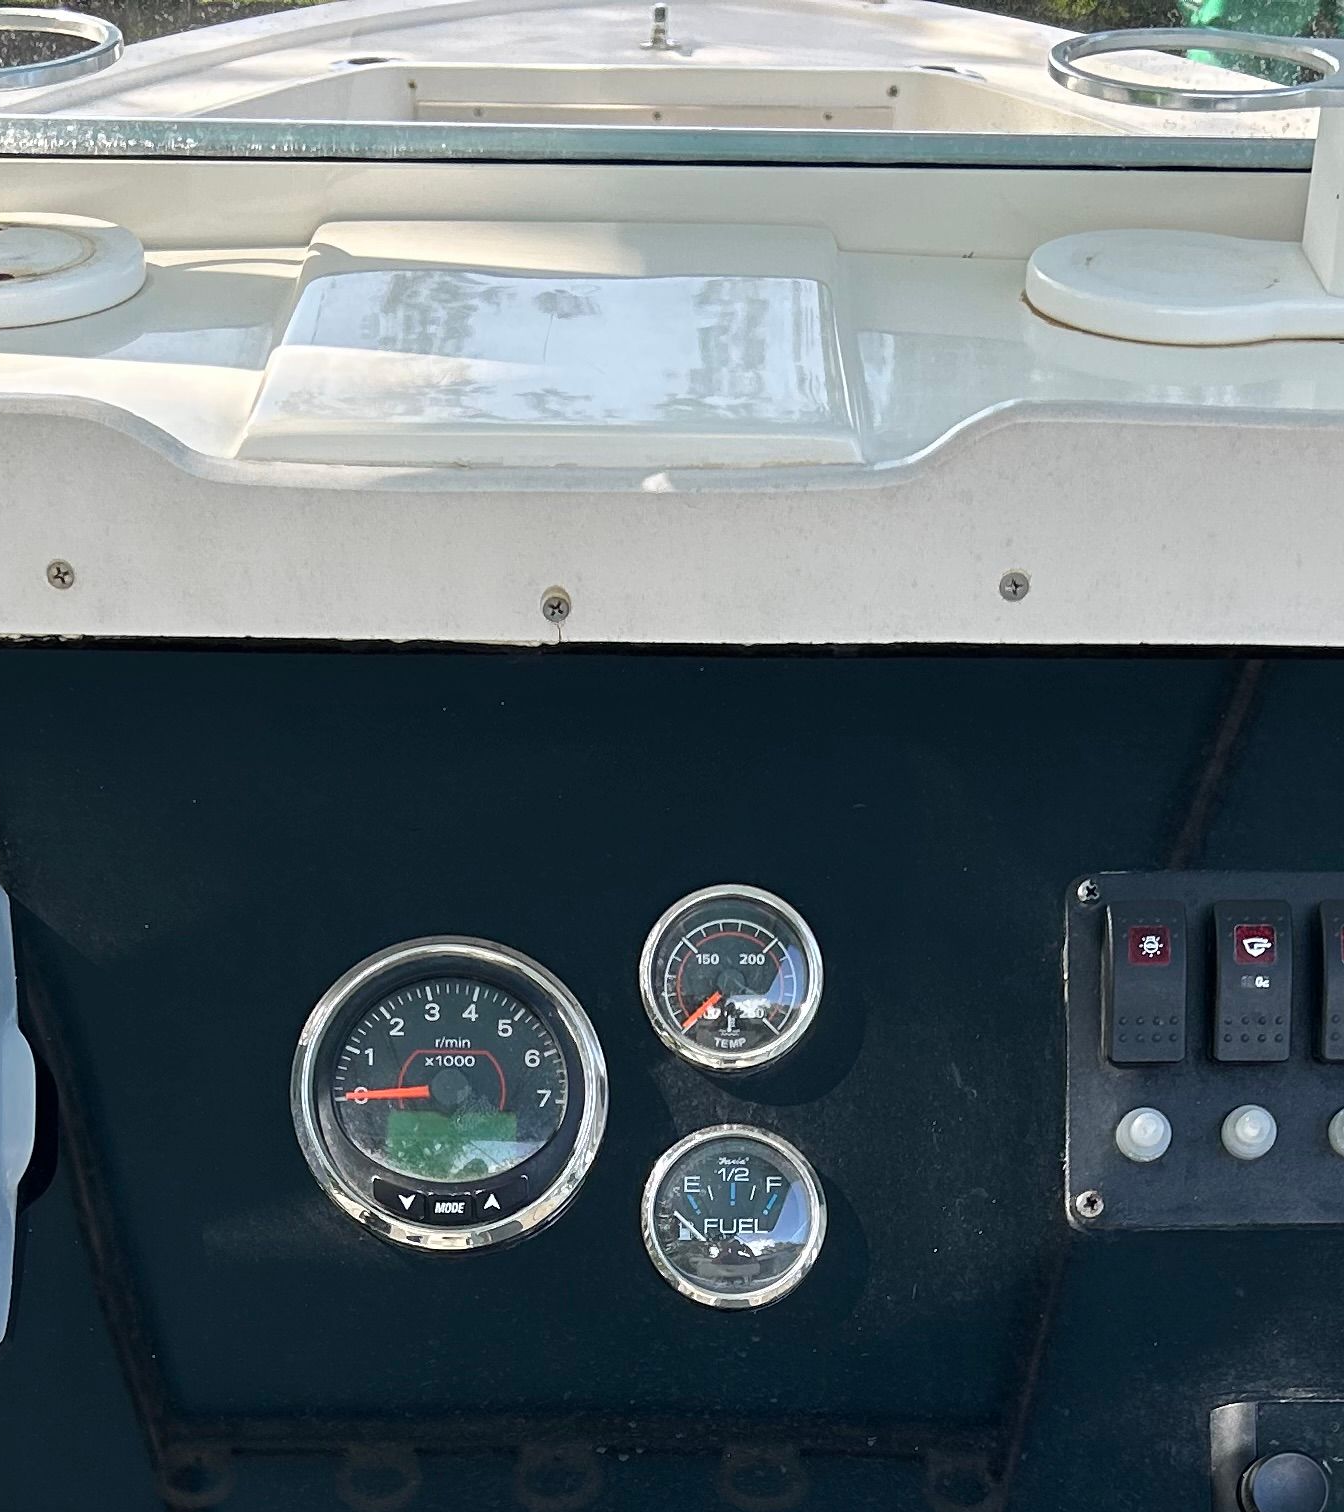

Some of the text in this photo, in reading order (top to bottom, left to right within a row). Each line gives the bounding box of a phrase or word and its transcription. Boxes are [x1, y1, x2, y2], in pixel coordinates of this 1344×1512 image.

[696, 953, 720, 965] 150
[739, 953, 766, 965] 200
[424, 1003, 441, 1022] 3
[462, 1004, 479, 1022] 4
[389, 1018, 405, 1036] 2
[497, 1019, 513, 1038] 5
[435, 1037, 471, 1050] r/min
[714, 1037, 746, 1049] TEMP
[364, 1048, 375, 1066] 1
[424, 1055, 476, 1068] x1000
[524, 1050, 541, 1068] 6
[536, 1089, 552, 1108] 7
[717, 1167, 750, 1182] 1/2
[683, 1175, 701, 1193] E
[766, 1176, 783, 1194] F
[434, 1201, 466, 1214] MODE
[703, 1218, 769, 1234] FUEL
